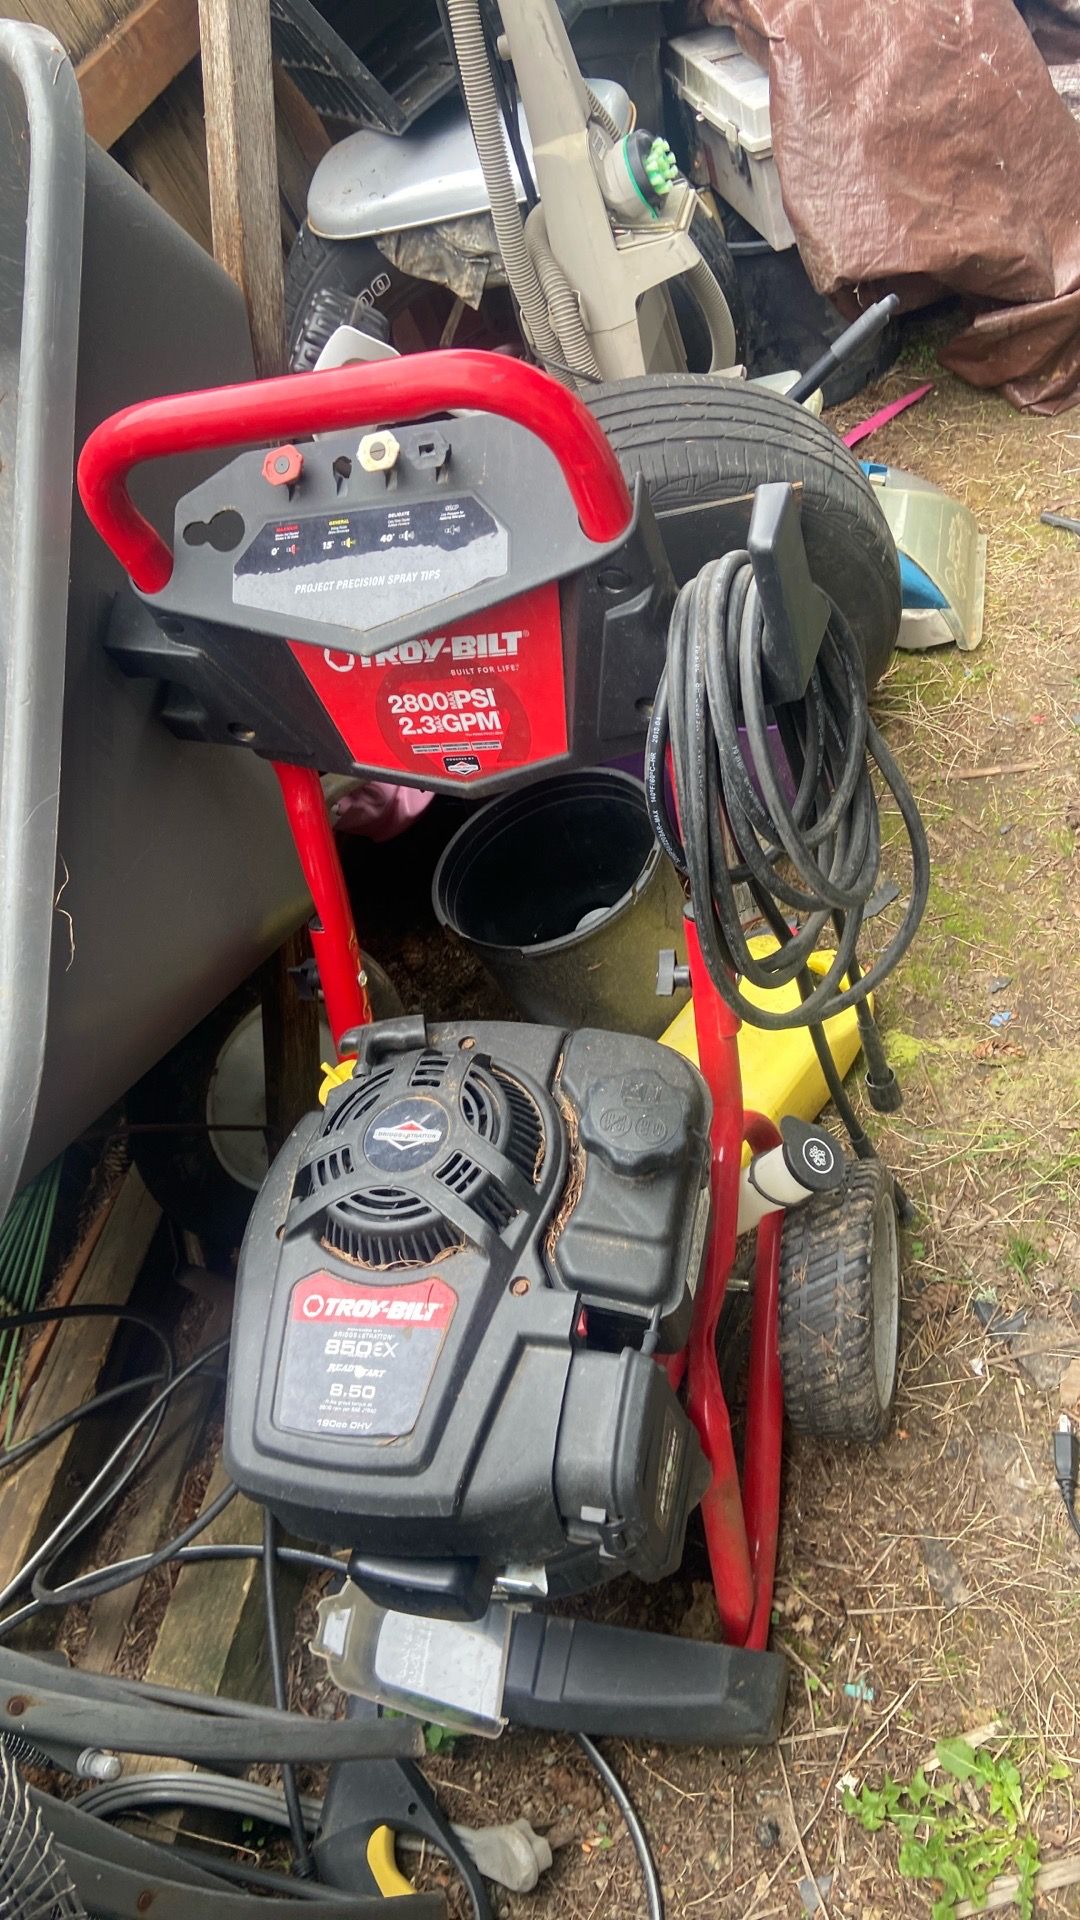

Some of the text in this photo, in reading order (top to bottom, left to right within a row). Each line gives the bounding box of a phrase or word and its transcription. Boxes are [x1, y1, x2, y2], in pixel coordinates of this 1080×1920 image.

[294, 569, 441, 594] PROJECT PRECISION SPRAY TIPS
[451, 668, 475, 677] BUILT
[478, 666, 495, 675] FOR
[388, 691, 449, 714] 2800
[454, 688, 497, 710] PSI
[399, 715, 437, 736] 2.3
[442, 711, 502, 733] GPM
[325, 1297, 443, 1321] TROY-BILT
[329, 1383, 376, 1399] 8.50
[350, 1421, 373, 1430] OHV
